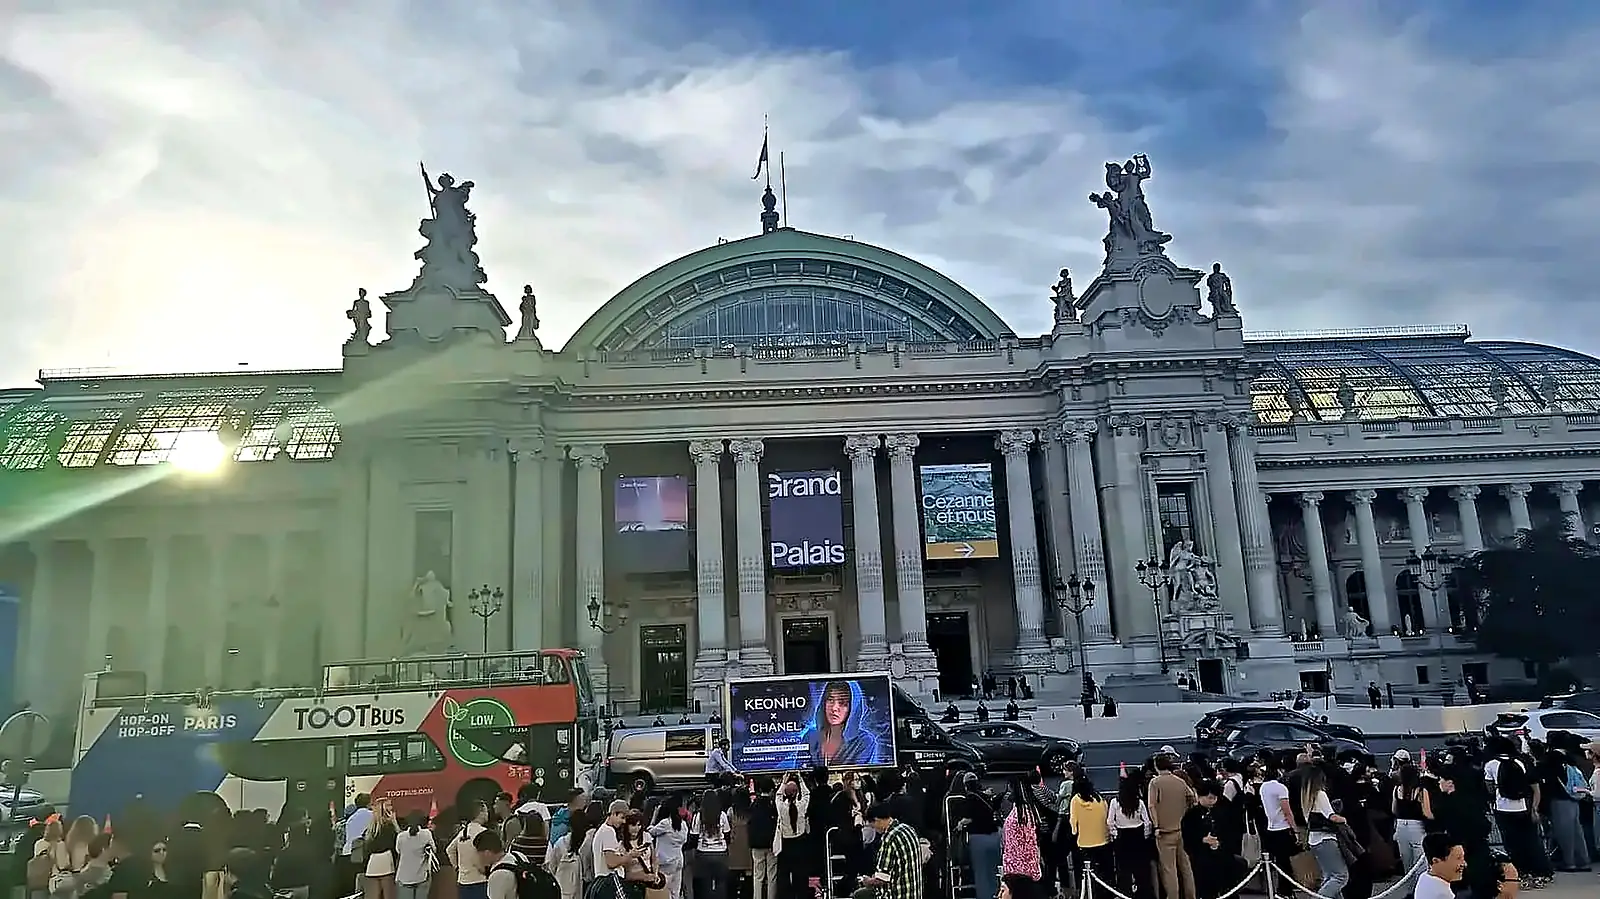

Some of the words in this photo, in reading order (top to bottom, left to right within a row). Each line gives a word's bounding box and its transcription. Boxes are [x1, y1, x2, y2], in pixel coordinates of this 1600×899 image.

[768, 471, 841, 498] Grand
[922, 494, 995, 509] Cezanne
[956, 509, 996, 523] nous
[770, 540, 845, 566] Palais
[744, 696, 806, 711] KEONHO
[120, 713, 170, 726] HOP-ON
[184, 715, 237, 731] PARIS
[470, 714, 494, 726] LOW
[119, 725, 176, 738] HOP-OFF
[750, 721, 803, 734] CHANEL
